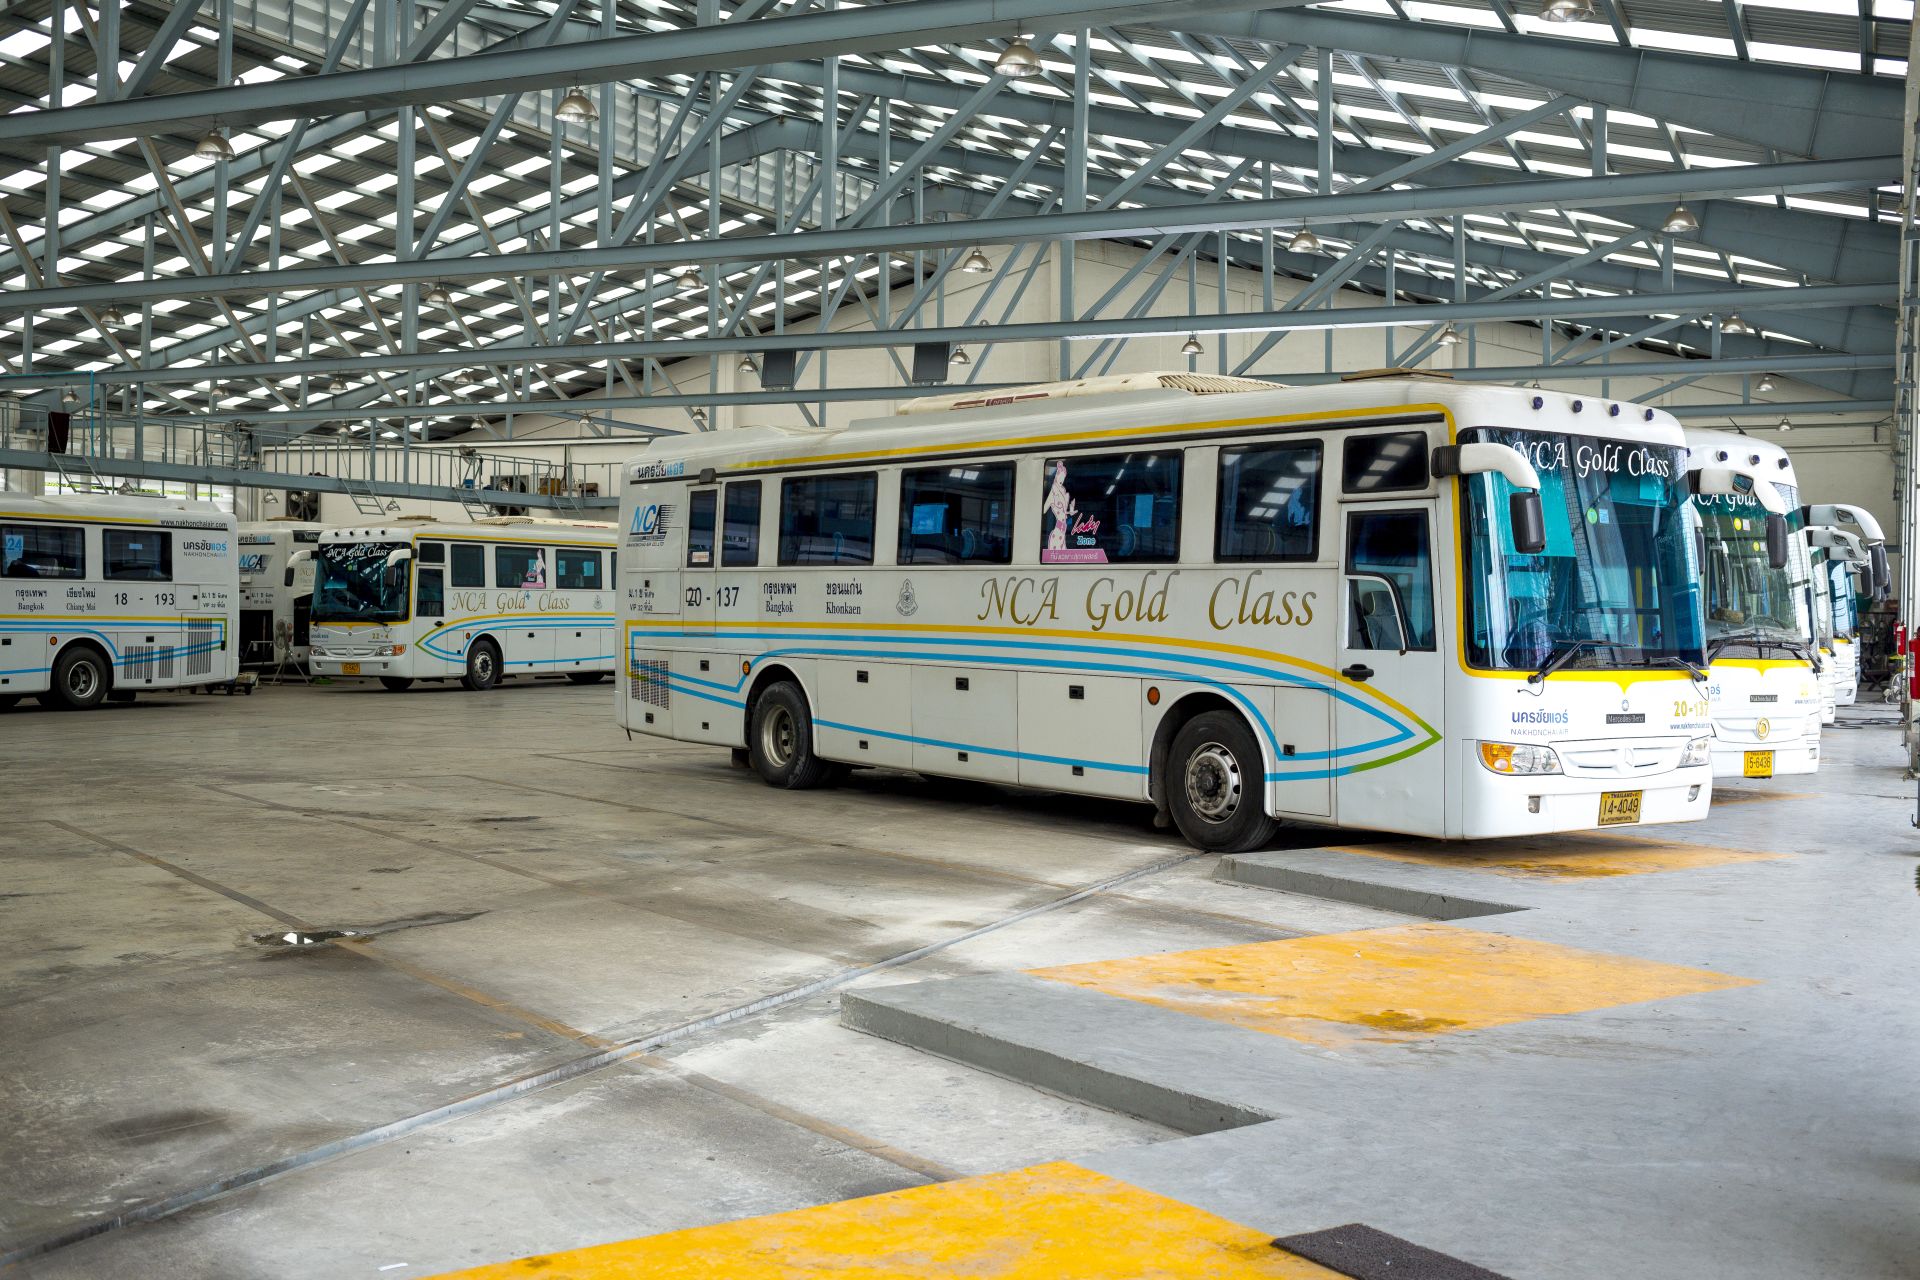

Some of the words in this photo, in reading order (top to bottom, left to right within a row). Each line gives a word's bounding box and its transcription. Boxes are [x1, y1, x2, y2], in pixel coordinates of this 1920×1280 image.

[1512, 441, 1568, 470] NCA
[1576, 445, 1622, 478] Gold
[1627, 445, 1669, 478] Class
[631, 504, 667, 534] NCA
[1071, 512, 1101, 535] Lady
[7, 538, 22, 551] 24
[1077, 536, 1096, 545] Zone
[348, 546, 365, 559] Gold
[368, 546, 388, 557] Class
[66, 588, 96, 598] เชียงใหม่
[686, 587, 701, 606] 20
[717, 587, 740, 607] 137
[763, 582, 797, 600] กรุงเทพฯ
[826, 578, 862, 595] ขอนแก่น
[18, 602, 44, 611] Bangkok
[66, 602, 84, 611] Chiang
[114, 593, 128, 605] 18
[154, 593, 175, 606] 193
[452, 591, 487, 612] NCA
[496, 590, 526, 614] Gold
[539, 590, 570, 612] Class
[977, 575, 1060, 625] NCA
[1085, 570, 1180, 631] Gold
[1208, 569, 1317, 630] Class
[765, 601, 793, 616] Bangkok
[826, 602, 861, 614] Khonkaen
[1512, 708, 1568, 723] นครชัยแอร์
[1674, 700, 1687, 717] 20
[1604, 798, 1639, 815] 14-4049
